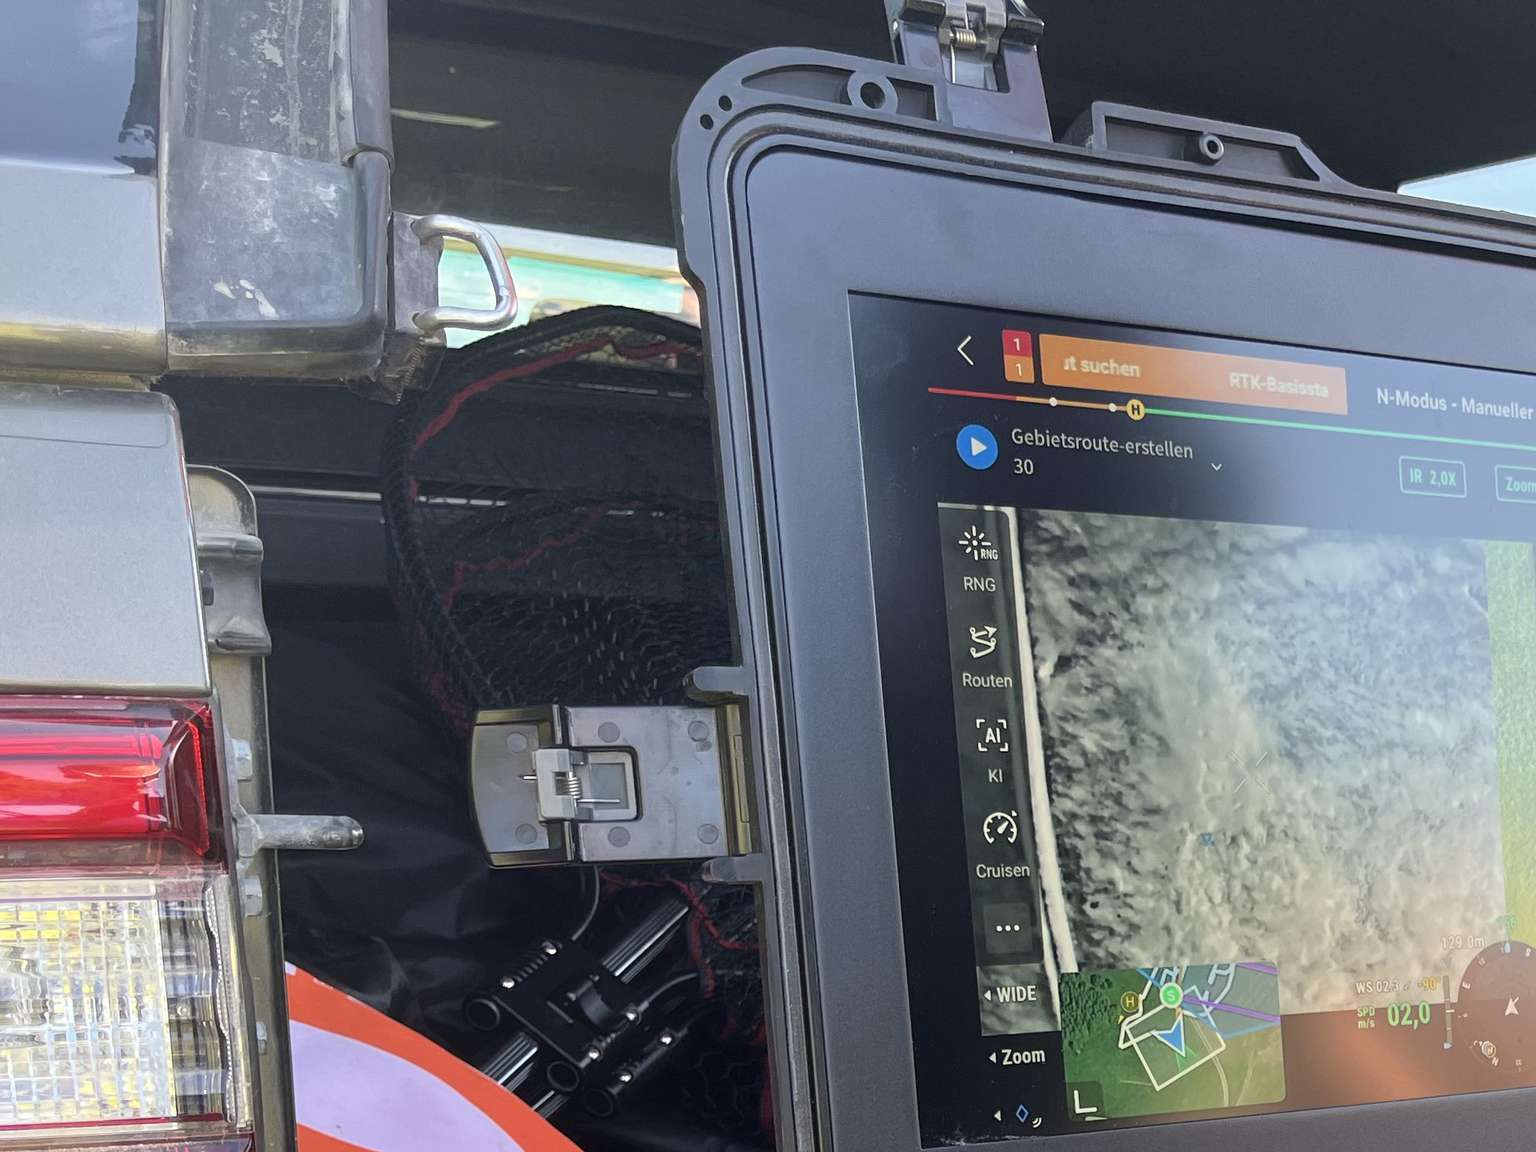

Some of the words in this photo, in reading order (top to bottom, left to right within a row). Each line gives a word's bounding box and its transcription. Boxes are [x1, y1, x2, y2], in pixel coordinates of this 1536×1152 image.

[1013, 338, 1020, 351] 1
[1015, 363, 1022, 377] 1
[1080, 359, 1142, 378] suchen
[1229, 372, 1329, 398] RTK-Basissta
[1377, 388, 1447, 413] N-Modus
[1461, 397, 1534, 422] Manueller
[1011, 427, 1194, 460] Gebietsroute-erstellen
[1013, 459, 1034, 476] 30
[1410, 469, 1423, 485] IR
[963, 576, 997, 593] RNG
[962, 672, 1013, 689] Routen
[988, 769, 1003, 784] KI
[975, 864, 1031, 879] Cruisen
[996, 985, 1037, 1004] WIDE
[1355, 982, 1373, 994] WS
[1357, 1019, 1376, 1029] m/s
[1387, 1001, 1431, 1030] 02,0
[1001, 1048, 1046, 1066] Zoom
